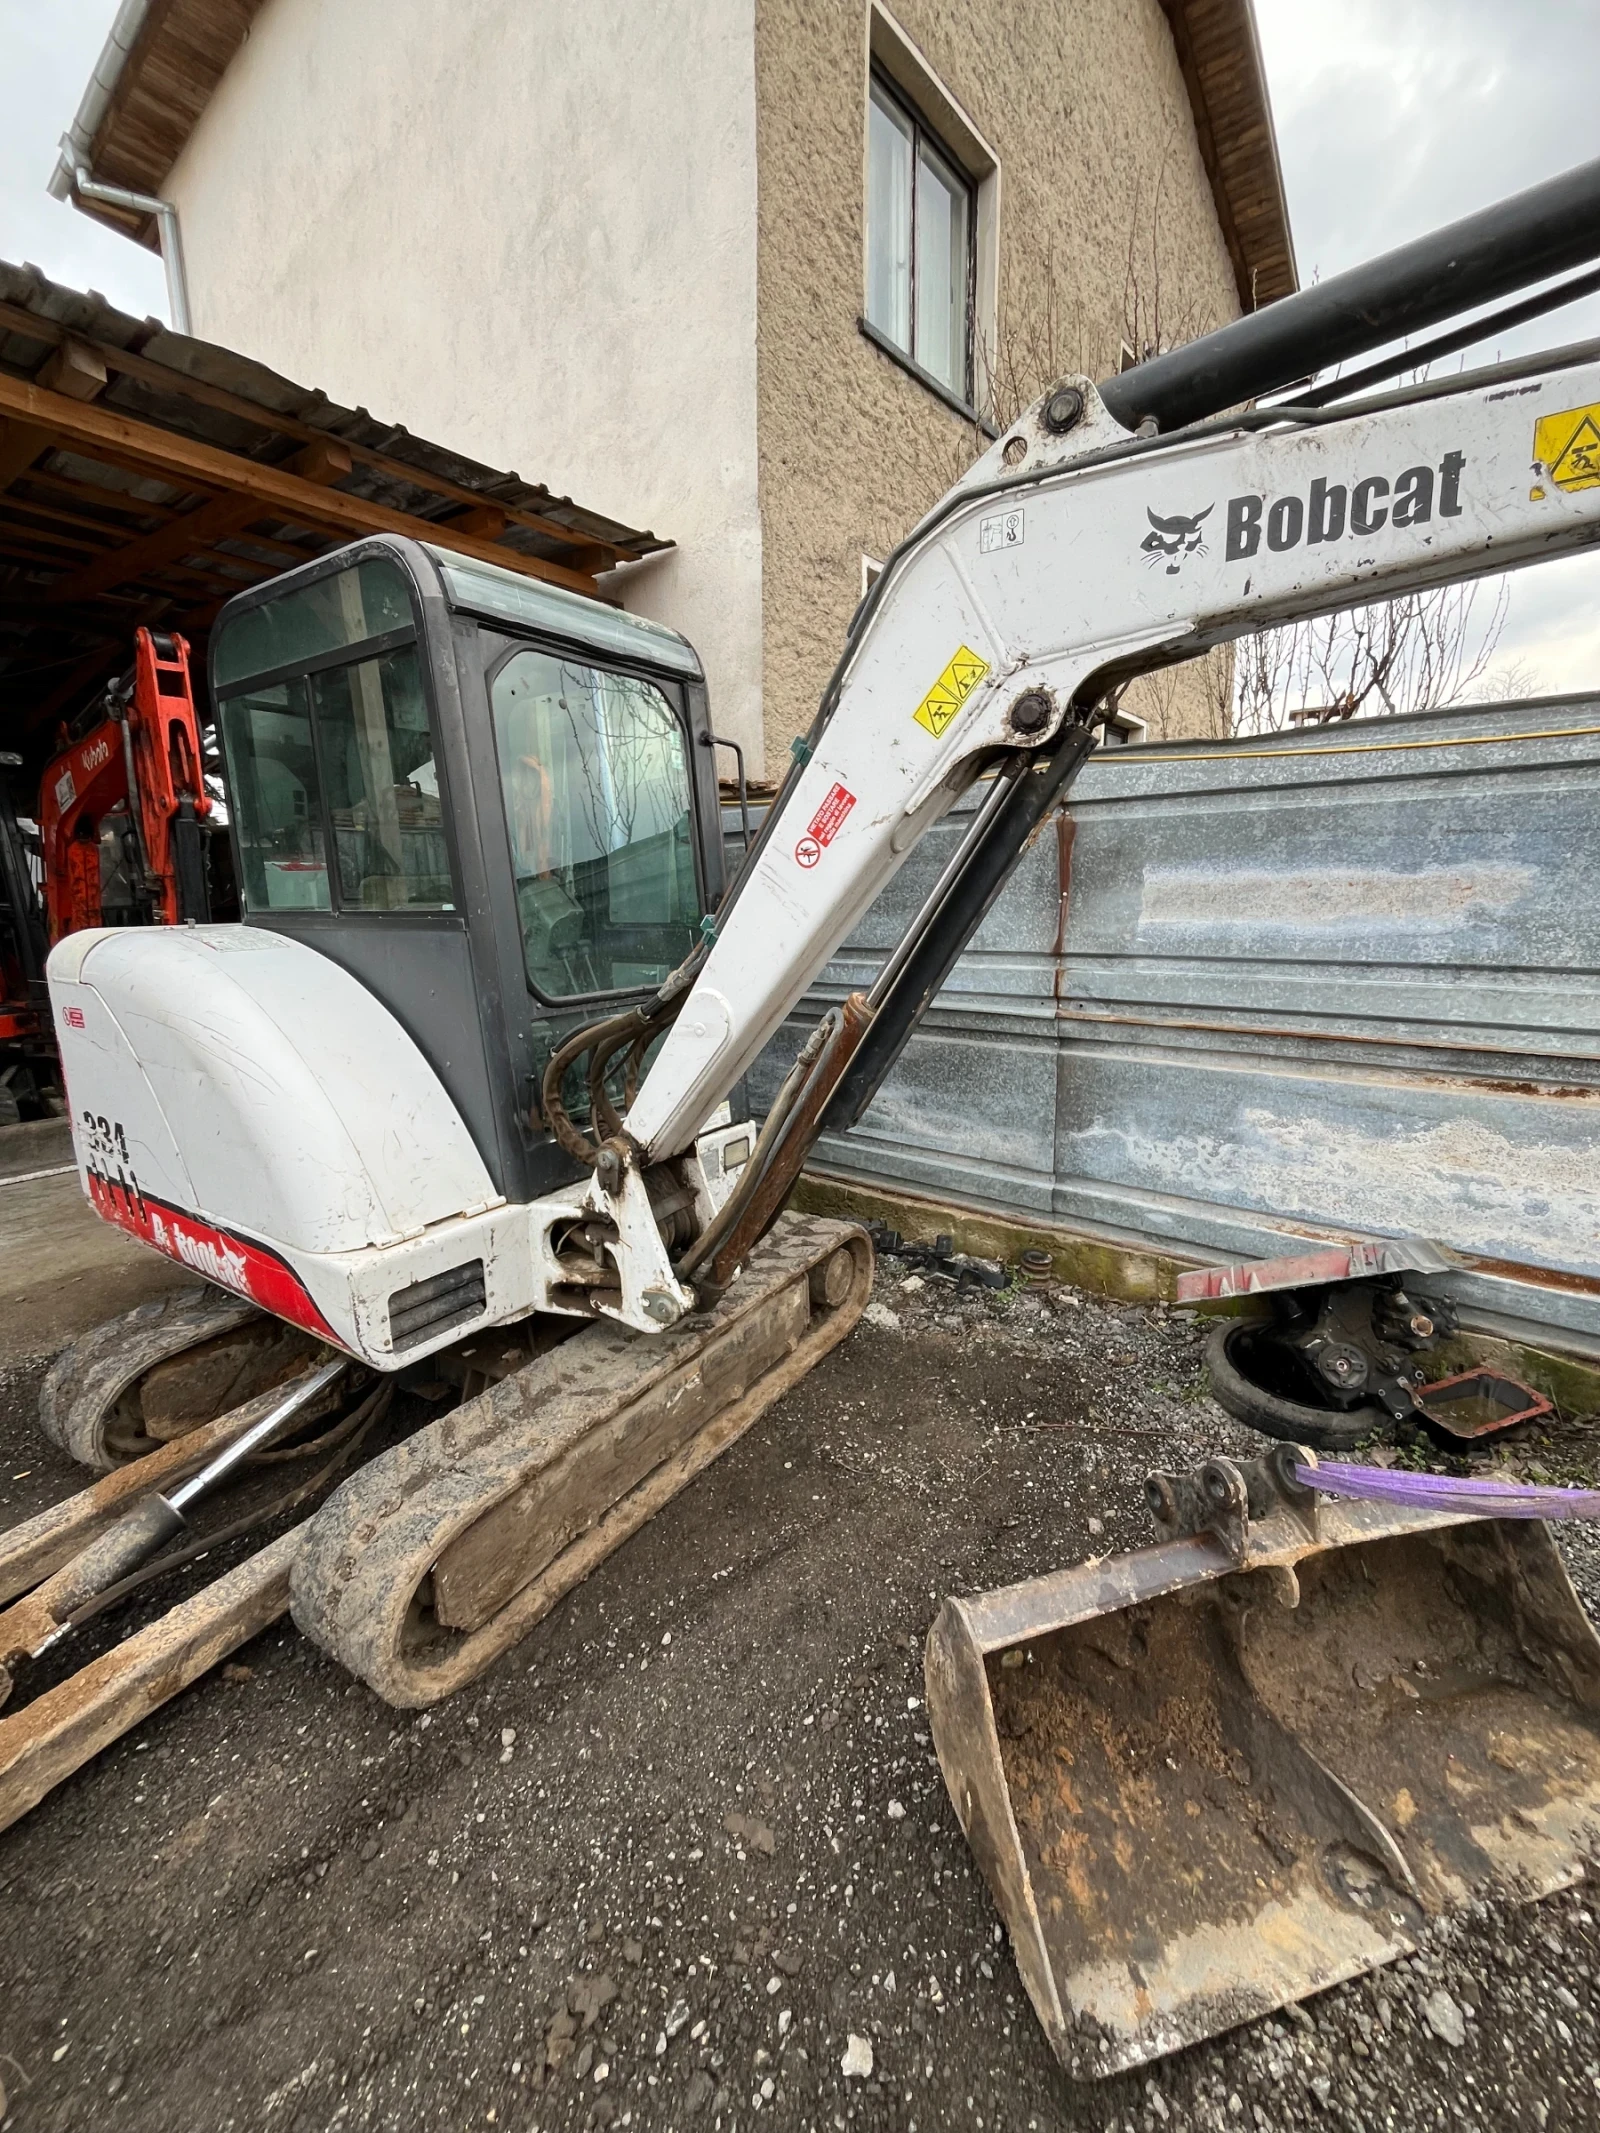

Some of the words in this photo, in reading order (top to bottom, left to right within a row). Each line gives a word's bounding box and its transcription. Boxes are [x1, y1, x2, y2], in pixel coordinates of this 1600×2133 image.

[1226, 450, 1466, 562] Bobcat
[82, 739, 109, 771] Kubota
[808, 809, 825, 833] VIETATO
[821, 784, 841, 812] PASSARE
[821, 797, 840, 824] SOSTARE
